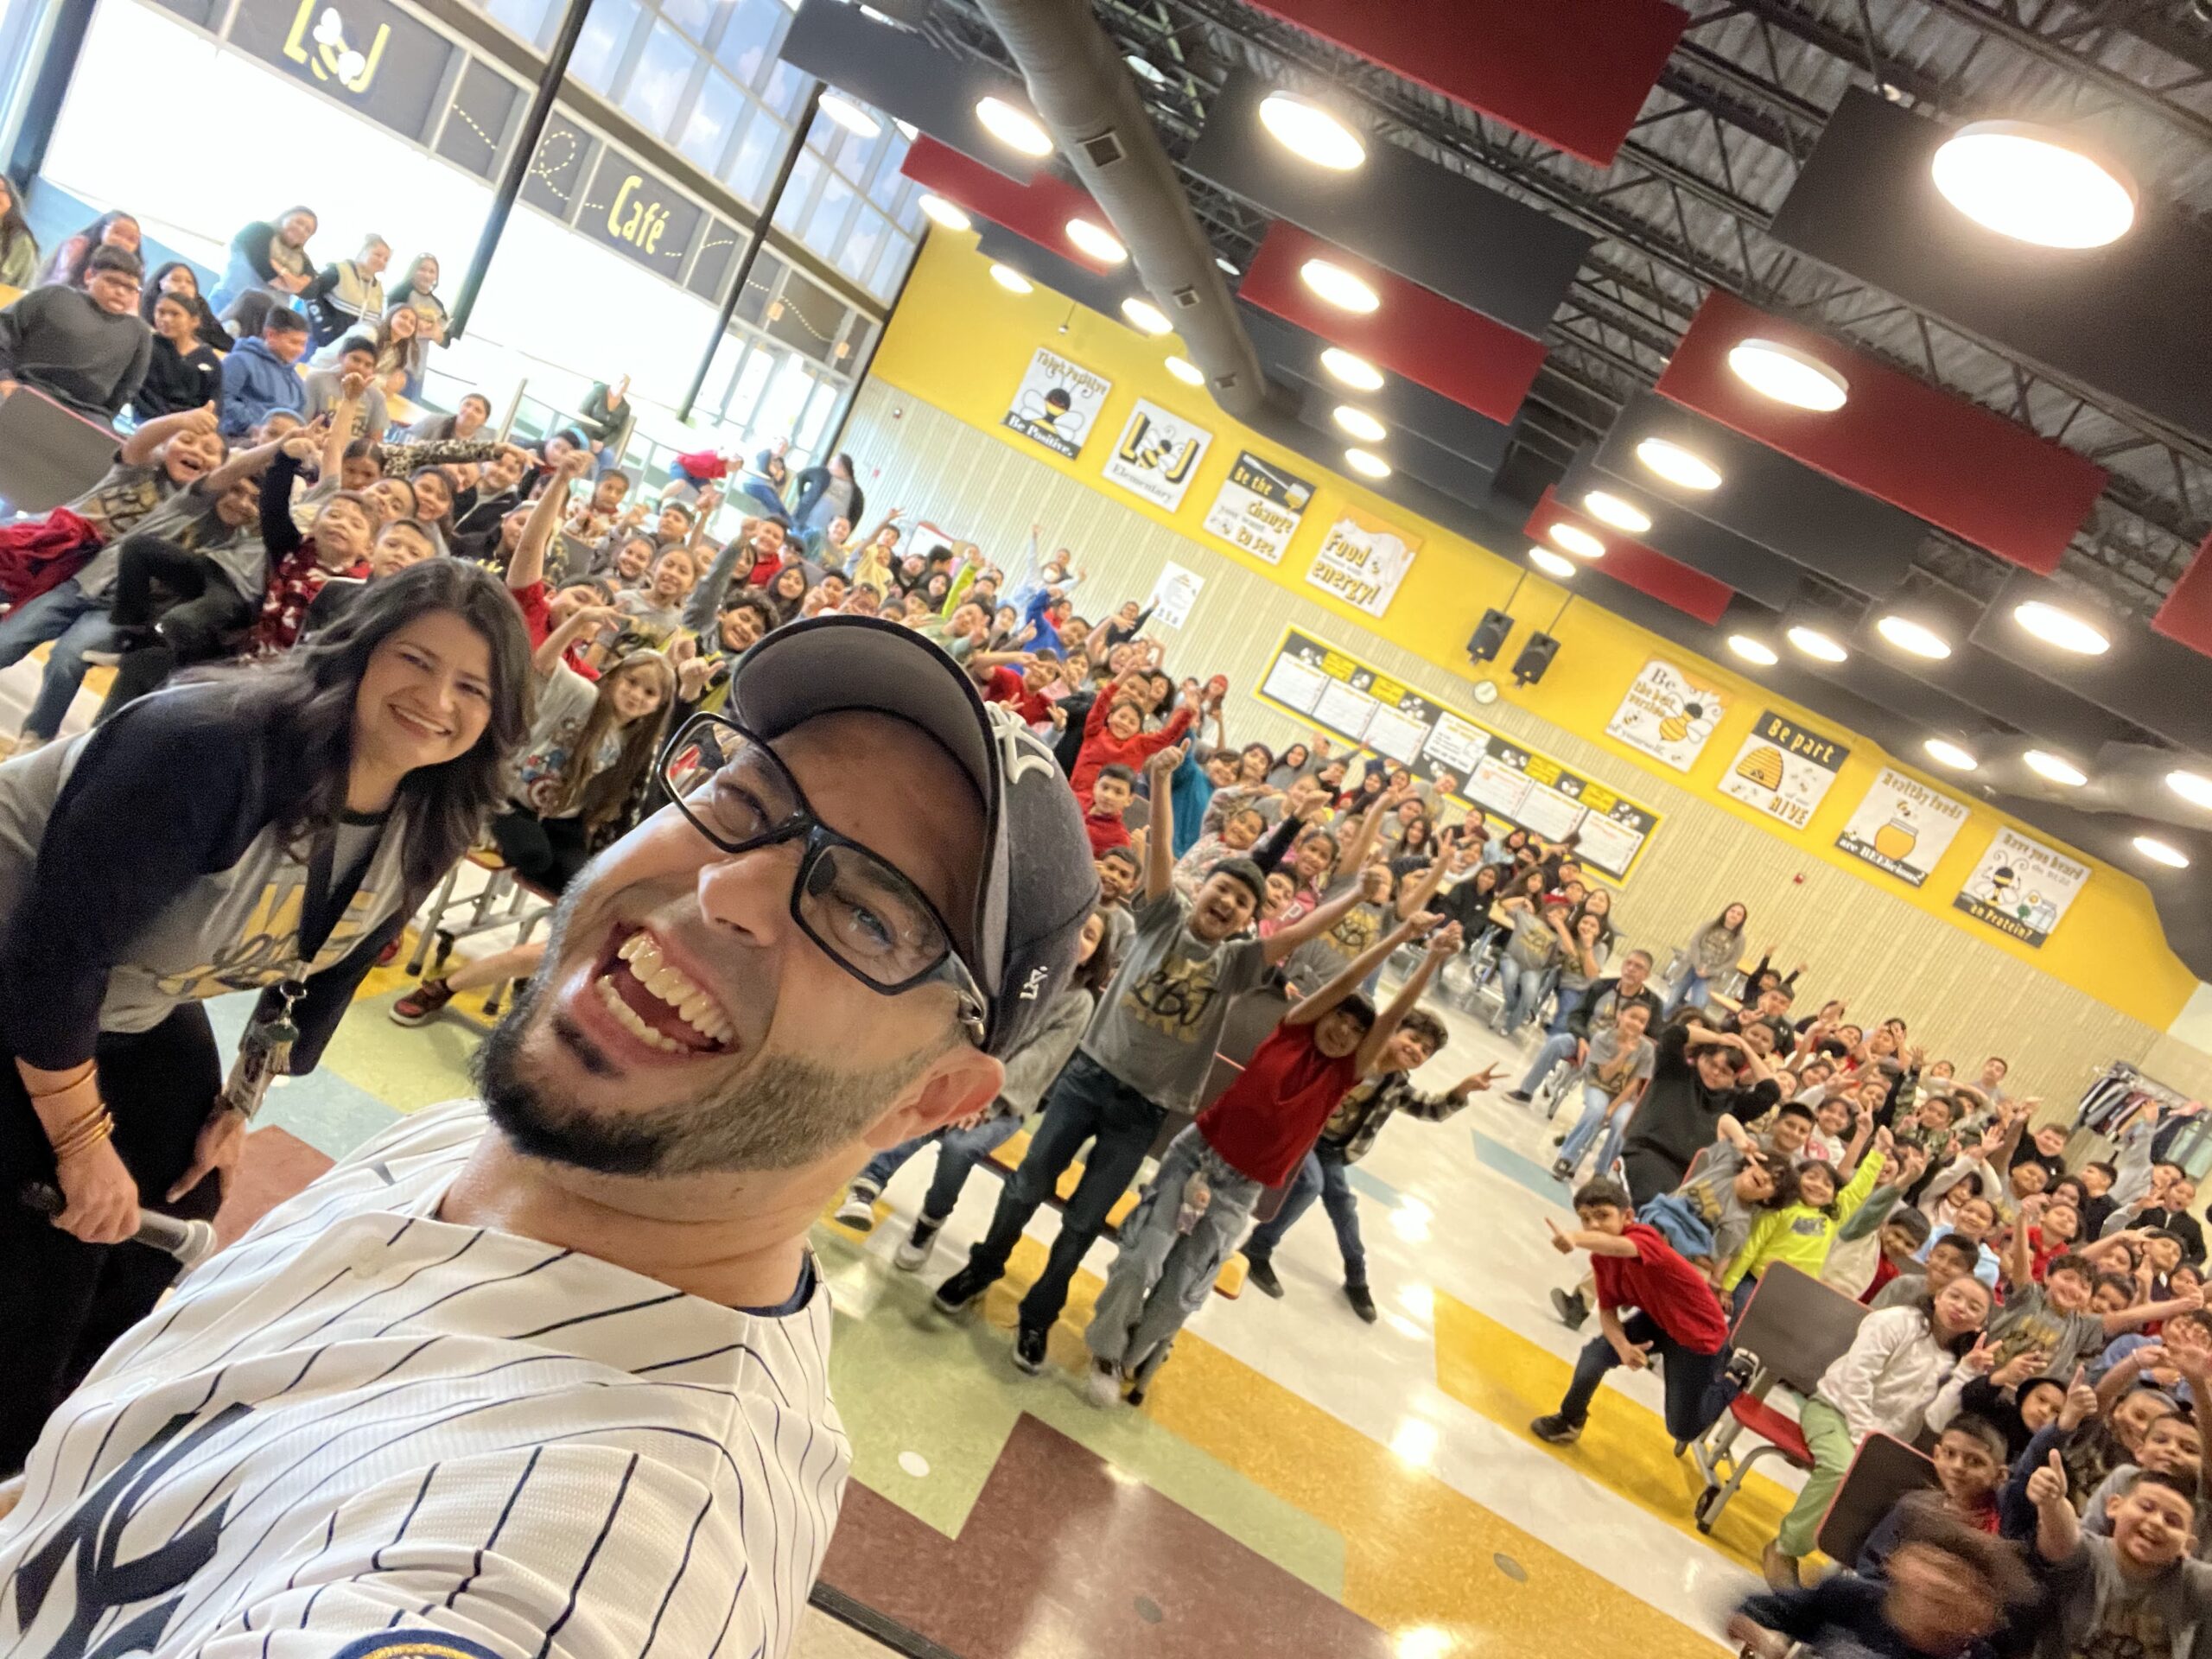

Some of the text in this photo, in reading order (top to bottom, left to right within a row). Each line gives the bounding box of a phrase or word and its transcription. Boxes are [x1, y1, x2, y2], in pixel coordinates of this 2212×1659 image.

[607, 174, 671, 257] Café
[1008, 416, 1075, 458] Be Positive.
[1112, 464, 1173, 502] Elementary
[1234, 467, 1274, 496] Be the
[1248, 499, 1294, 535] change
[1235, 525, 1277, 560] to see.
[1325, 531, 1373, 569] Food
[1312, 559, 1382, 606] energy!
[1650, 667, 1677, 690] Be
[1767, 717, 1834, 764] Be part
[1769, 795, 1809, 826] HIVE
[1881, 771, 1964, 821] Healthy foods
[1839, 837, 1859, 853] are
[2002, 832, 2031, 855] Have
[2051, 854, 2085, 881] heard
[1986, 908, 2034, 941] Protein?
